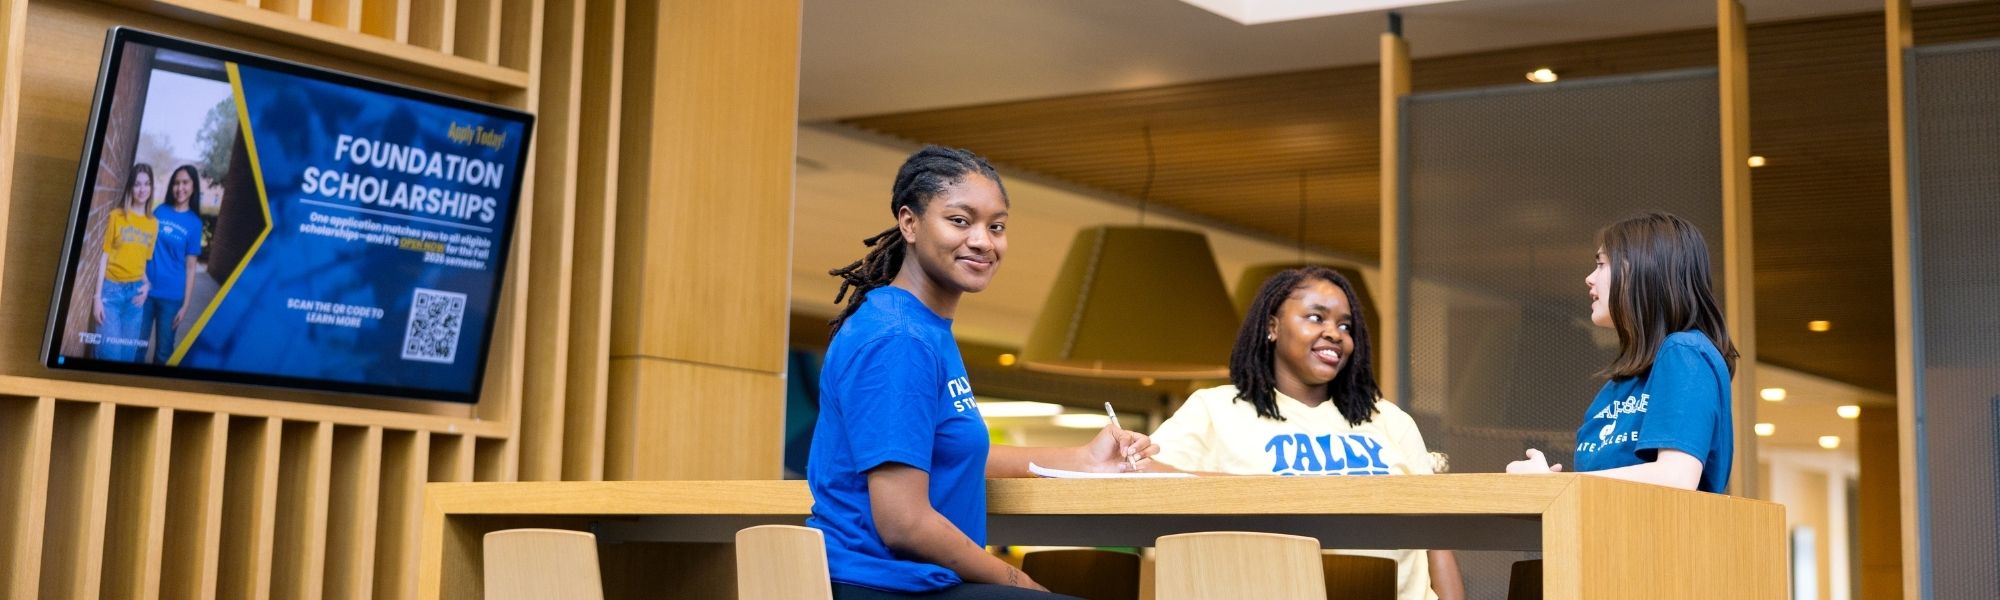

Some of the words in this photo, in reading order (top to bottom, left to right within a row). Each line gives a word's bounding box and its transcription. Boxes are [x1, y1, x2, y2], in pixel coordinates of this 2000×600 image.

[448, 121, 474, 146] Apply
[475, 126, 506, 152] Today!
[334, 134, 504, 190] FOUNDATION
[302, 166, 497, 224] SCHOLARSHIPS
[310, 211, 329, 224] One
[330, 215, 382, 231] application
[383, 223, 421, 238] matches
[422, 230, 439, 242] you
[440, 231, 449, 242] to
[449, 233, 460, 244] all
[461, 235, 491, 249] eligible
[446, 243, 459, 255] for
[459, 245, 474, 257] the
[474, 247, 490, 260] Fall
[287, 298, 314, 311] SCAN
[315, 301, 333, 313] THE
[333, 303, 346, 315] QR
[346, 304, 371, 318] CODE
[371, 307, 384, 320] TO
[306, 312, 335, 325] LEARN
[336, 316, 362, 328] MORE
[106, 336, 149, 347] FOUNDATION
[1264, 433, 1389, 473] TALLY
